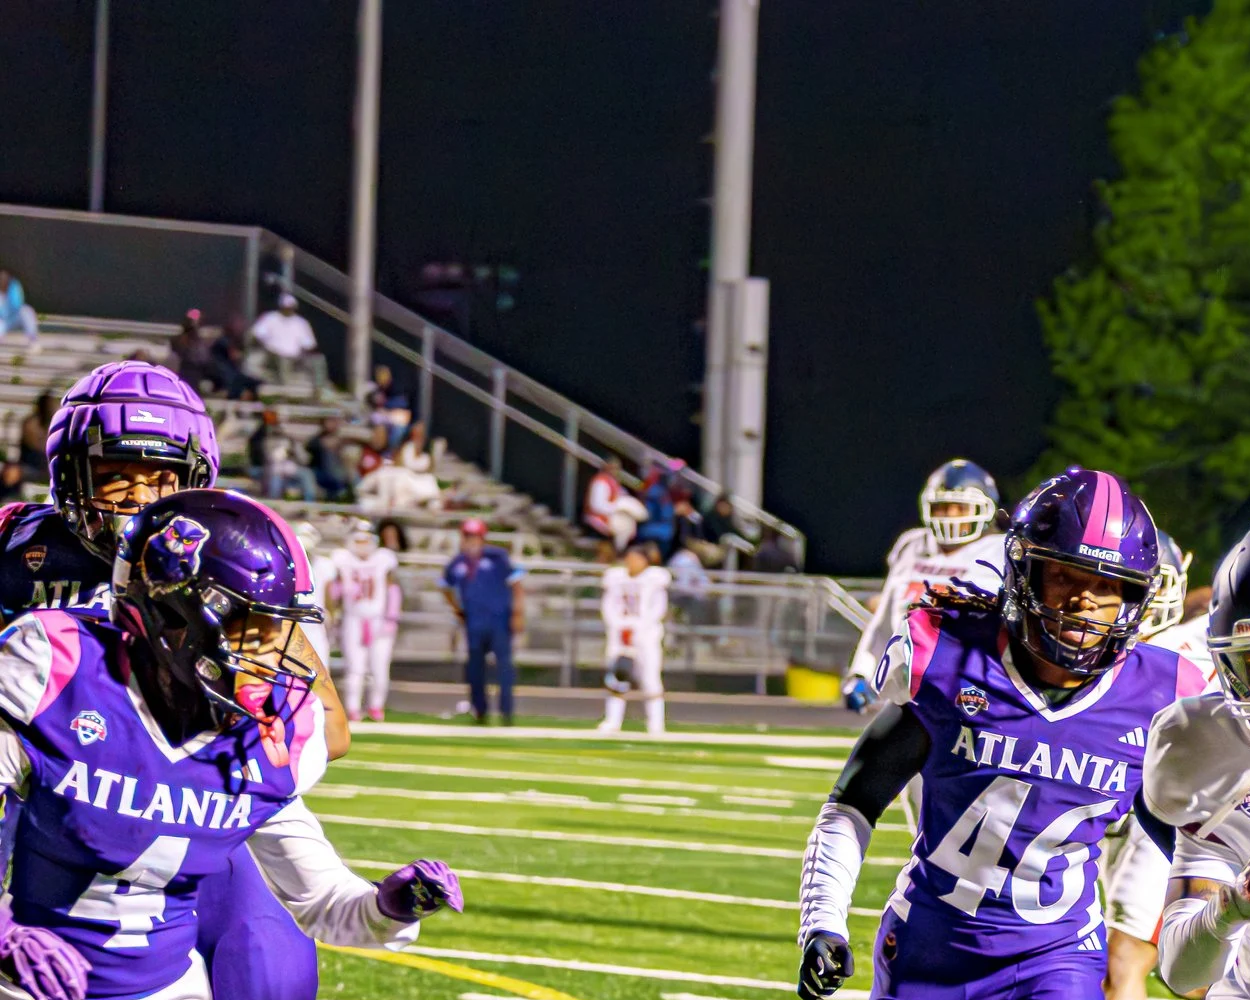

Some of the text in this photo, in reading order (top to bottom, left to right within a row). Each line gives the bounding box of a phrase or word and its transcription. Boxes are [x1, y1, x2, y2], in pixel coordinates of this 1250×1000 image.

[1079, 544, 1120, 562] Riddell
[22, 580, 112, 609] ATLA
[951, 725, 1129, 792] ATLANTA
[53, 760, 251, 829] ATLANTA
[927, 775, 1120, 924] 46
[68, 835, 190, 948] 4
